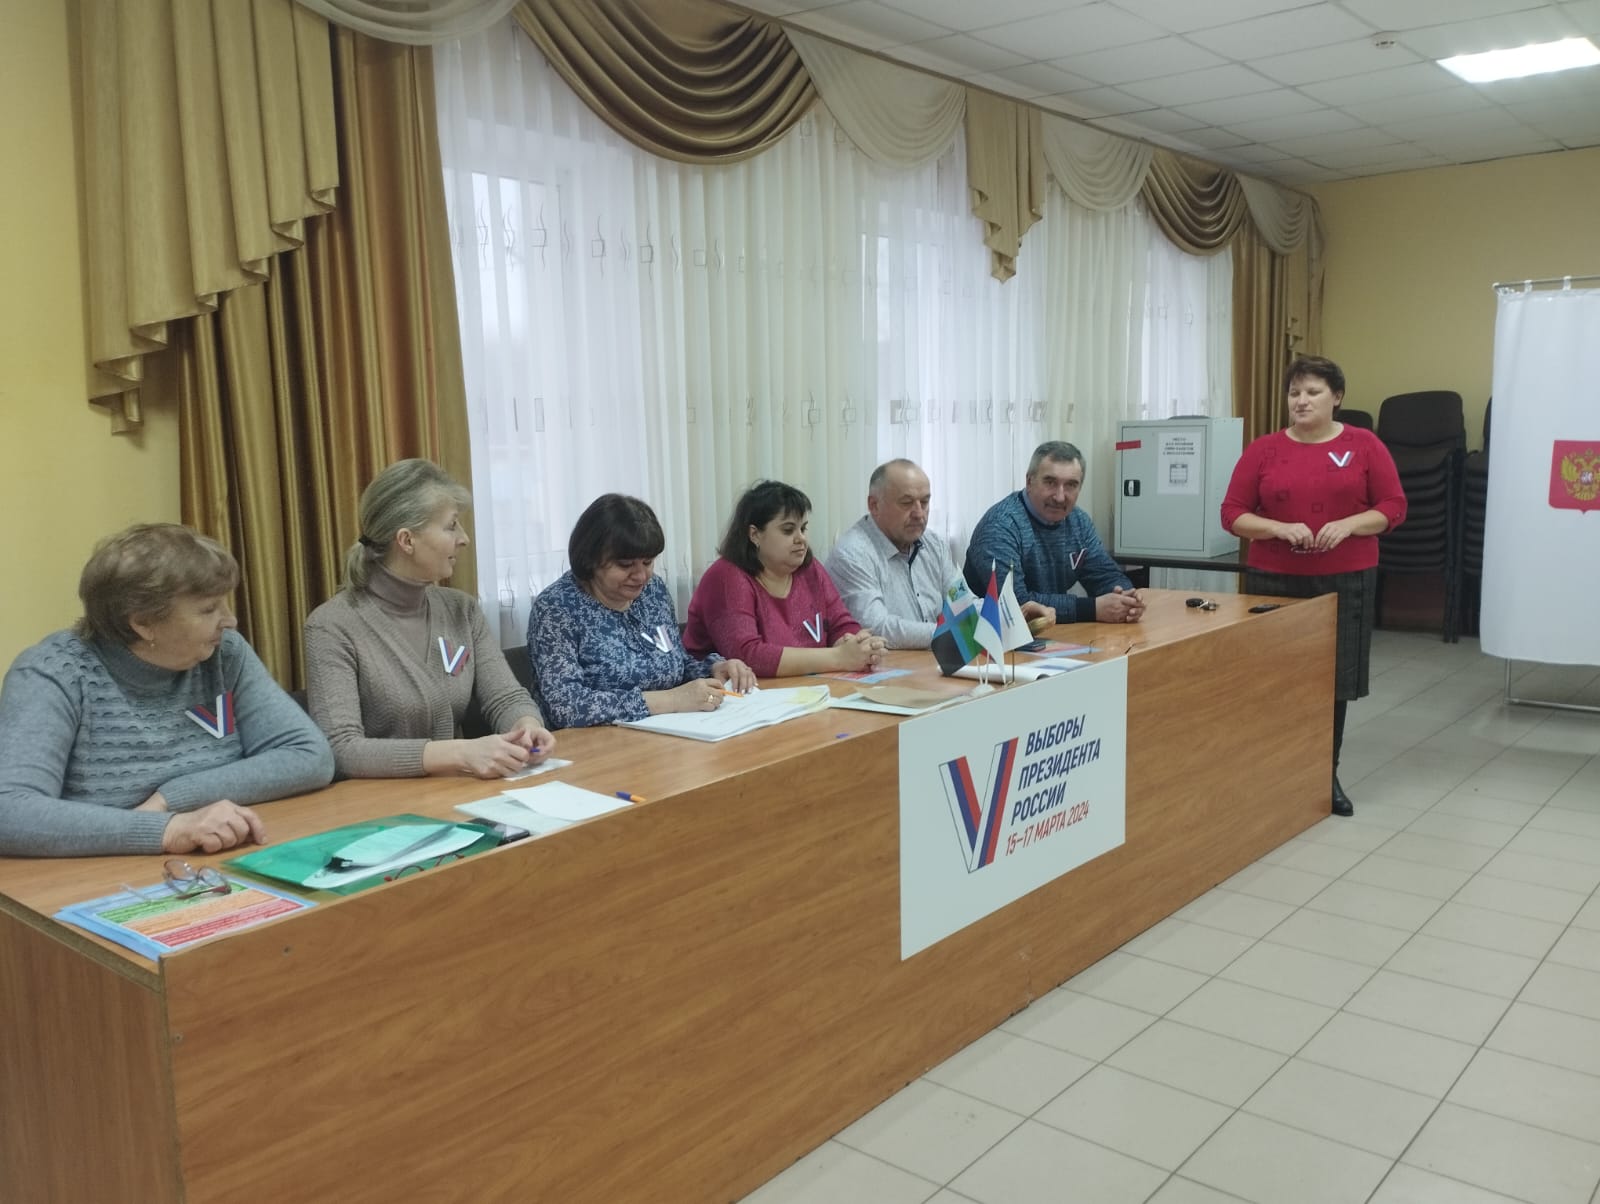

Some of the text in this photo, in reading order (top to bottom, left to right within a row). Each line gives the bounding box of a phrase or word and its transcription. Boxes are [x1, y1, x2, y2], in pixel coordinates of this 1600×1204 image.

[1025, 714, 1086, 757] ВЫБОРЫ
[1018, 737, 1101, 791] ПРЕЗИДЕНТА
[1010, 781, 1067, 826] РОССИИ
[1033, 810, 1066, 843] МАРТА
[1066, 799, 1090, 827] 2024
